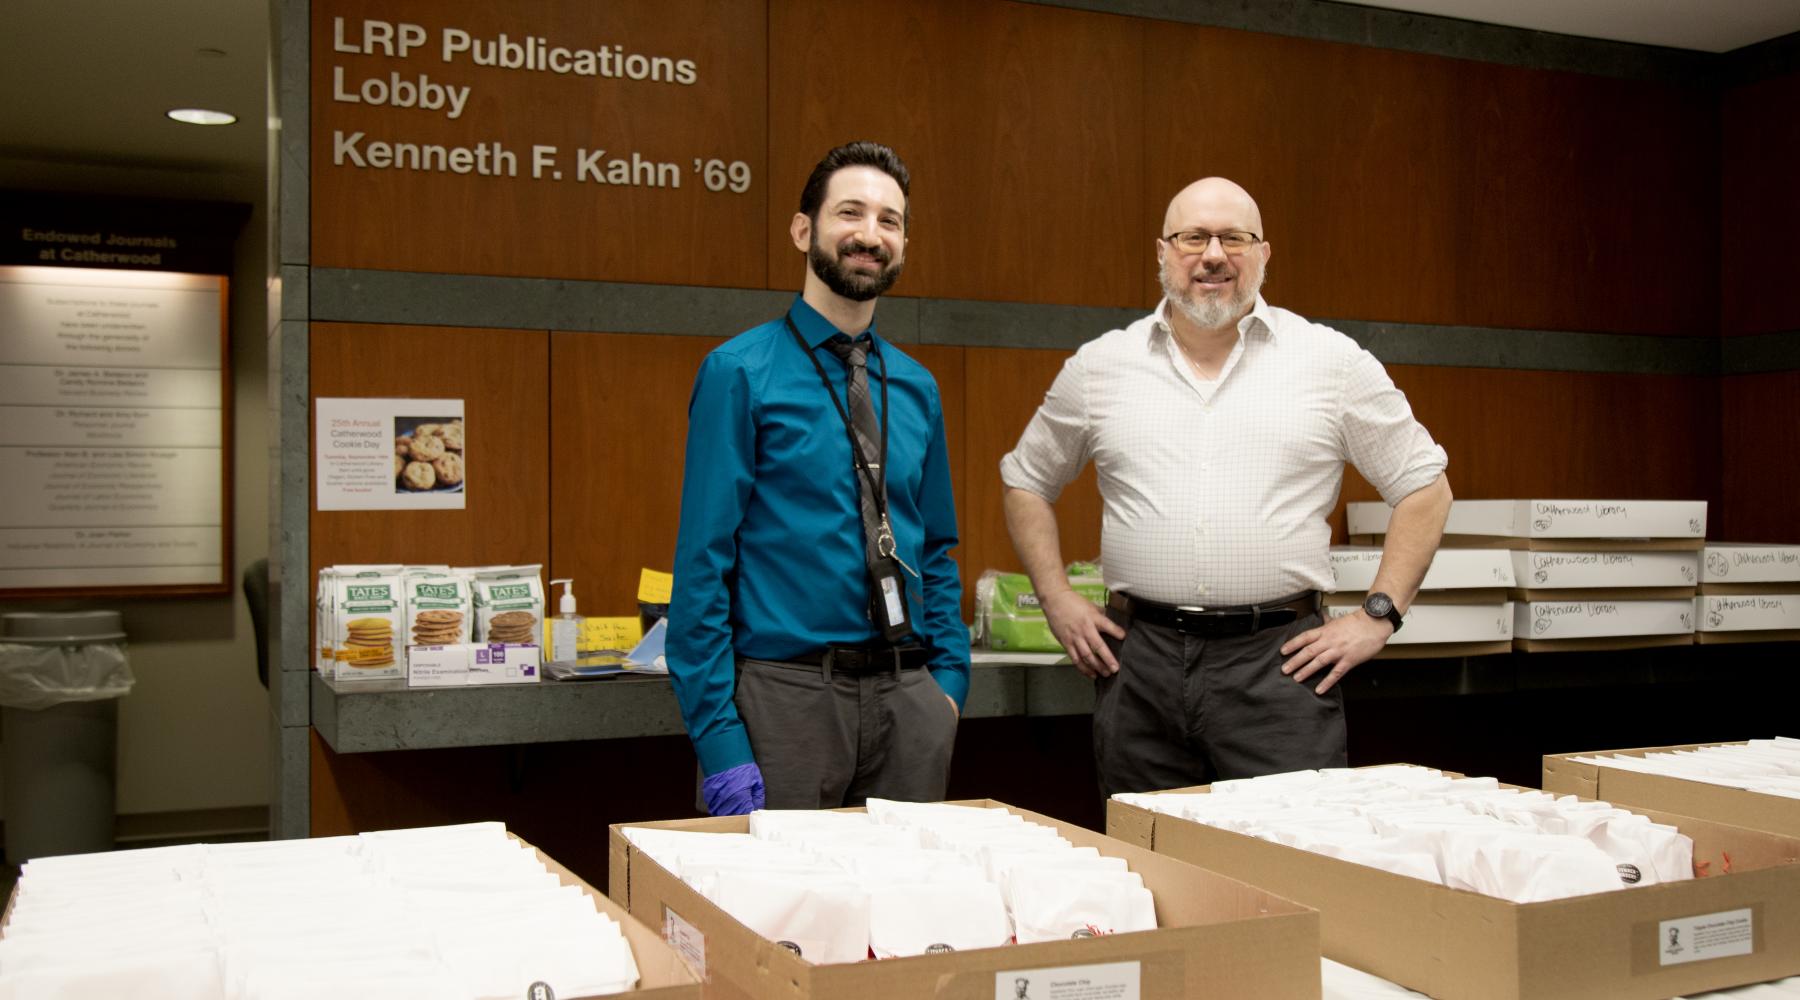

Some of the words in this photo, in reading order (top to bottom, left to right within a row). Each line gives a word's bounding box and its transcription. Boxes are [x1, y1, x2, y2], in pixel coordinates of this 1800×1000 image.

[333, 17, 428, 58] LRP
[441, 27, 698, 85] Publications
[333, 65, 471, 119] Lobby
[332, 129, 518, 178] Kenneth
[531, 144, 563, 181] F.
[576, 147, 681, 189] Kahn
[22, 228, 102, 245] Endowed
[105, 233, 177, 249] Journals
[39, 248, 56, 261] at
[60, 248, 162, 265] Catherwood
[331, 419, 351, 428] 25th
[352, 419, 381, 428] Annual
[330, 429, 382, 438] Catherwood
[332, 440, 363, 449] Cookie
[364, 440, 380, 450] Day
[1595, 504, 1628, 519] Library
[1533, 553, 1598, 570] Catherwood
[1602, 553, 1634, 569] Library
